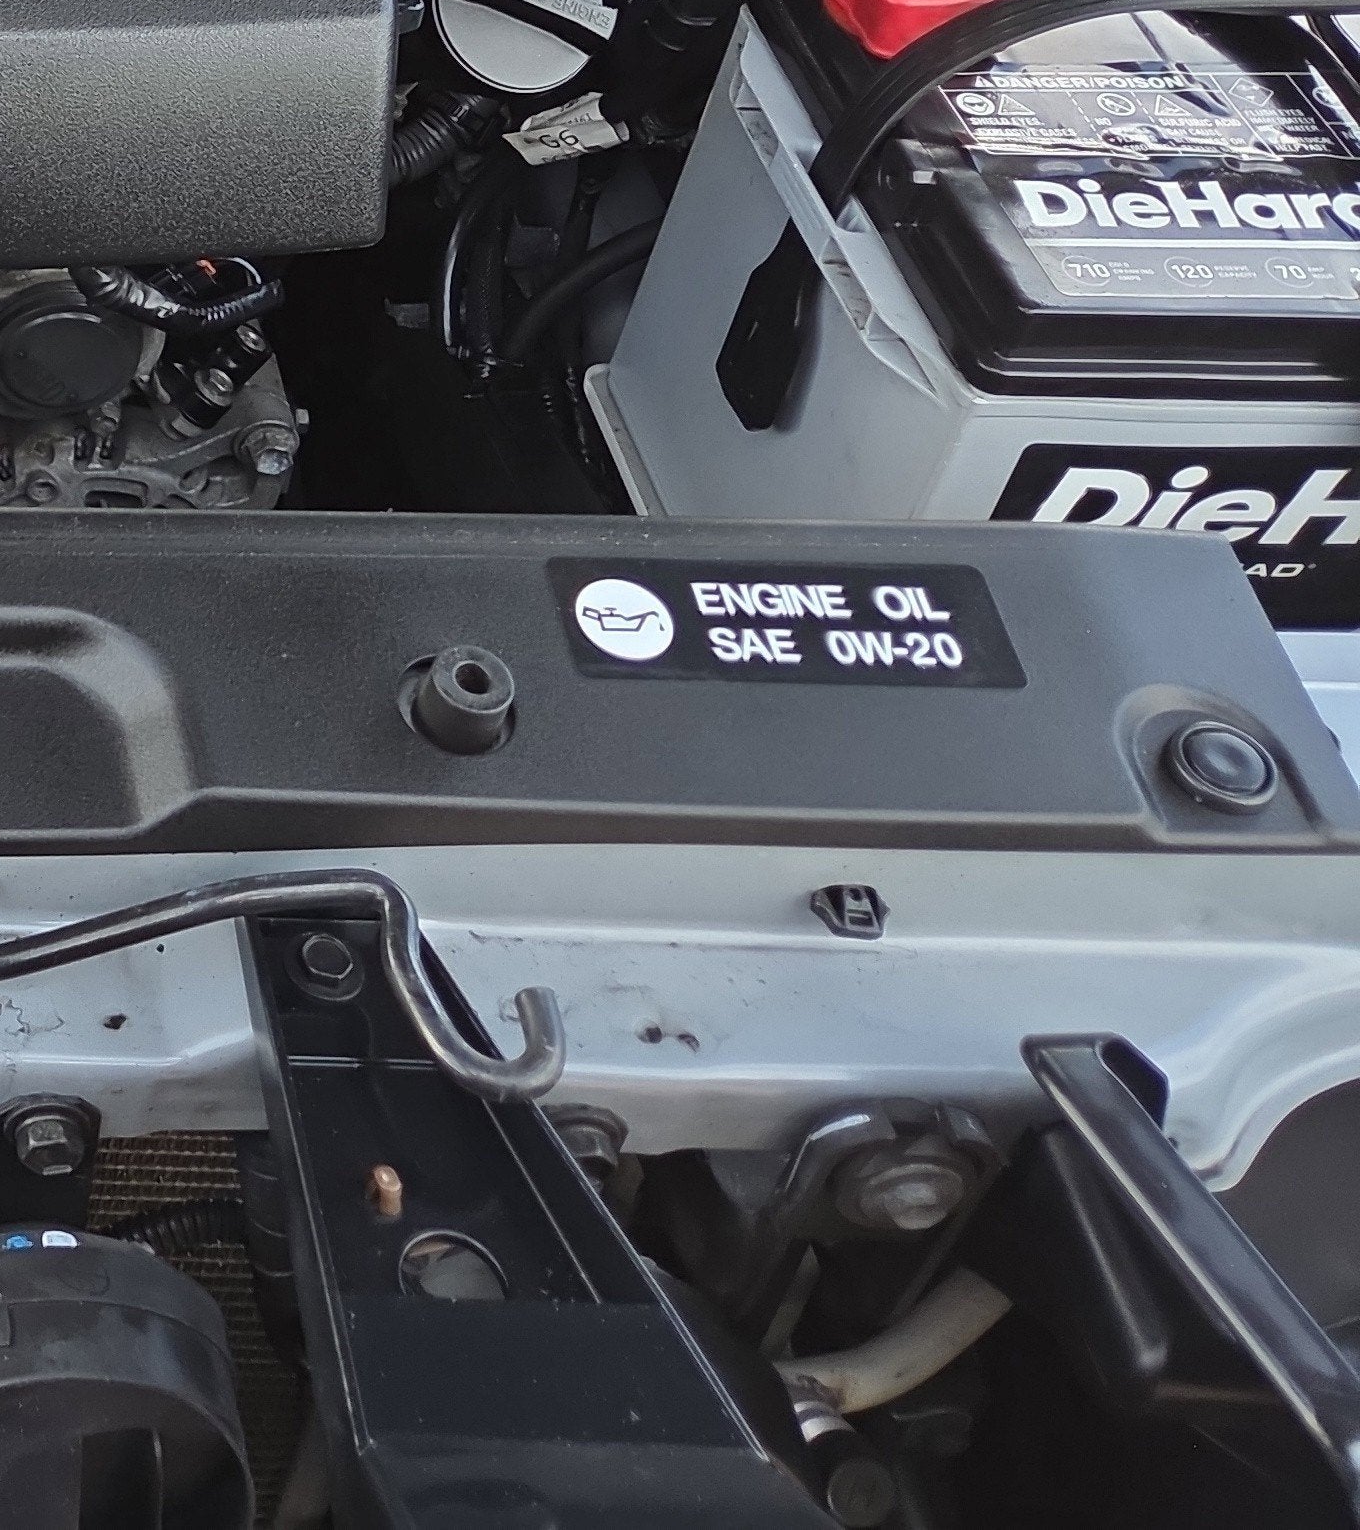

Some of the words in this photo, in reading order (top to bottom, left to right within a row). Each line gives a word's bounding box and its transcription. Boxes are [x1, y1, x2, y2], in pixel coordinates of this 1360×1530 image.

[993, 75, 1184, 90] DANGER/POISON
[1067, 263, 1111, 278] 710
[1171, 264, 1214, 279] 120
[1273, 265, 1307, 280] 70
[690, 581, 854, 620] ENGINE
[871, 585, 952, 623] OIL
[706, 626, 803, 665] SAE
[824, 630, 964, 669] 0W-20
